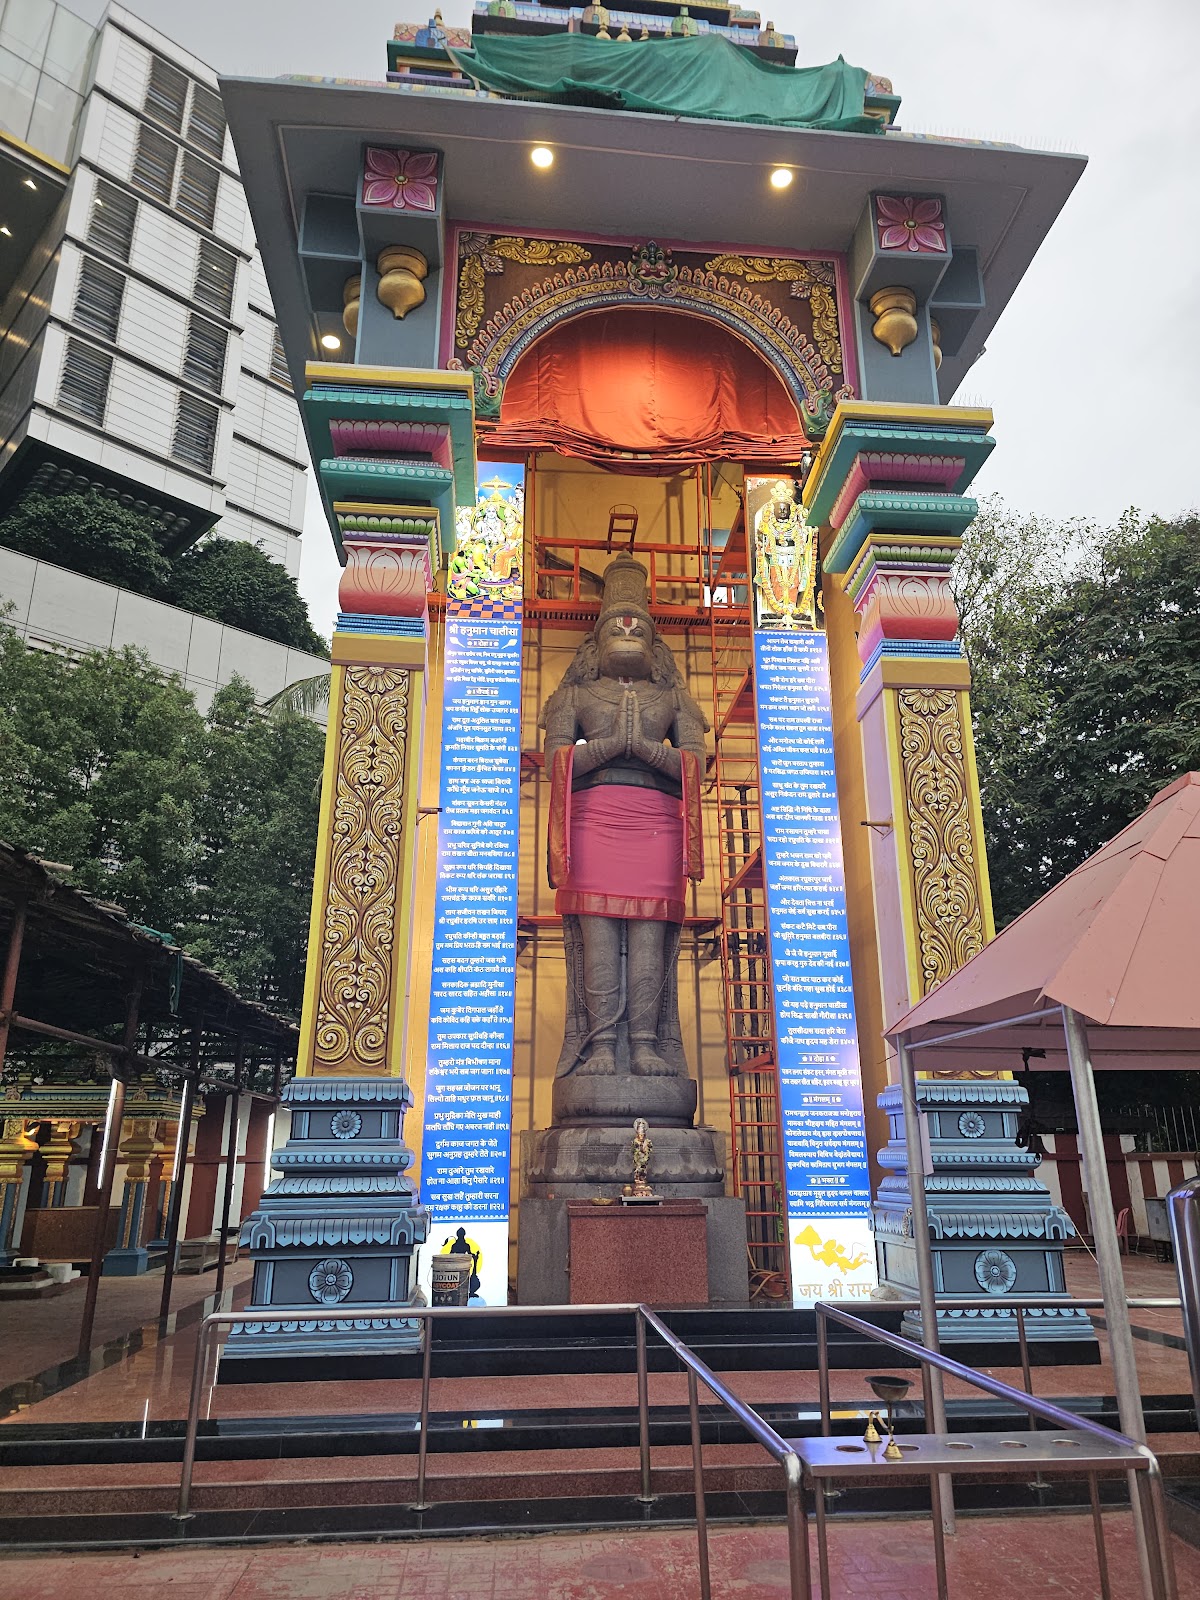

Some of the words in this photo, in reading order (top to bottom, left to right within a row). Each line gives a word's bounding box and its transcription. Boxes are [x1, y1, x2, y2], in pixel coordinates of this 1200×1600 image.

[449, 624, 459, 636] श्री
[459, 626, 488, 637] हनुमान
[489, 625, 518, 636] चालीसा
[798, 1283, 823, 1298] जय
[828, 1278, 844, 1298] श्री
[847, 1283, 872, 1297] राम
